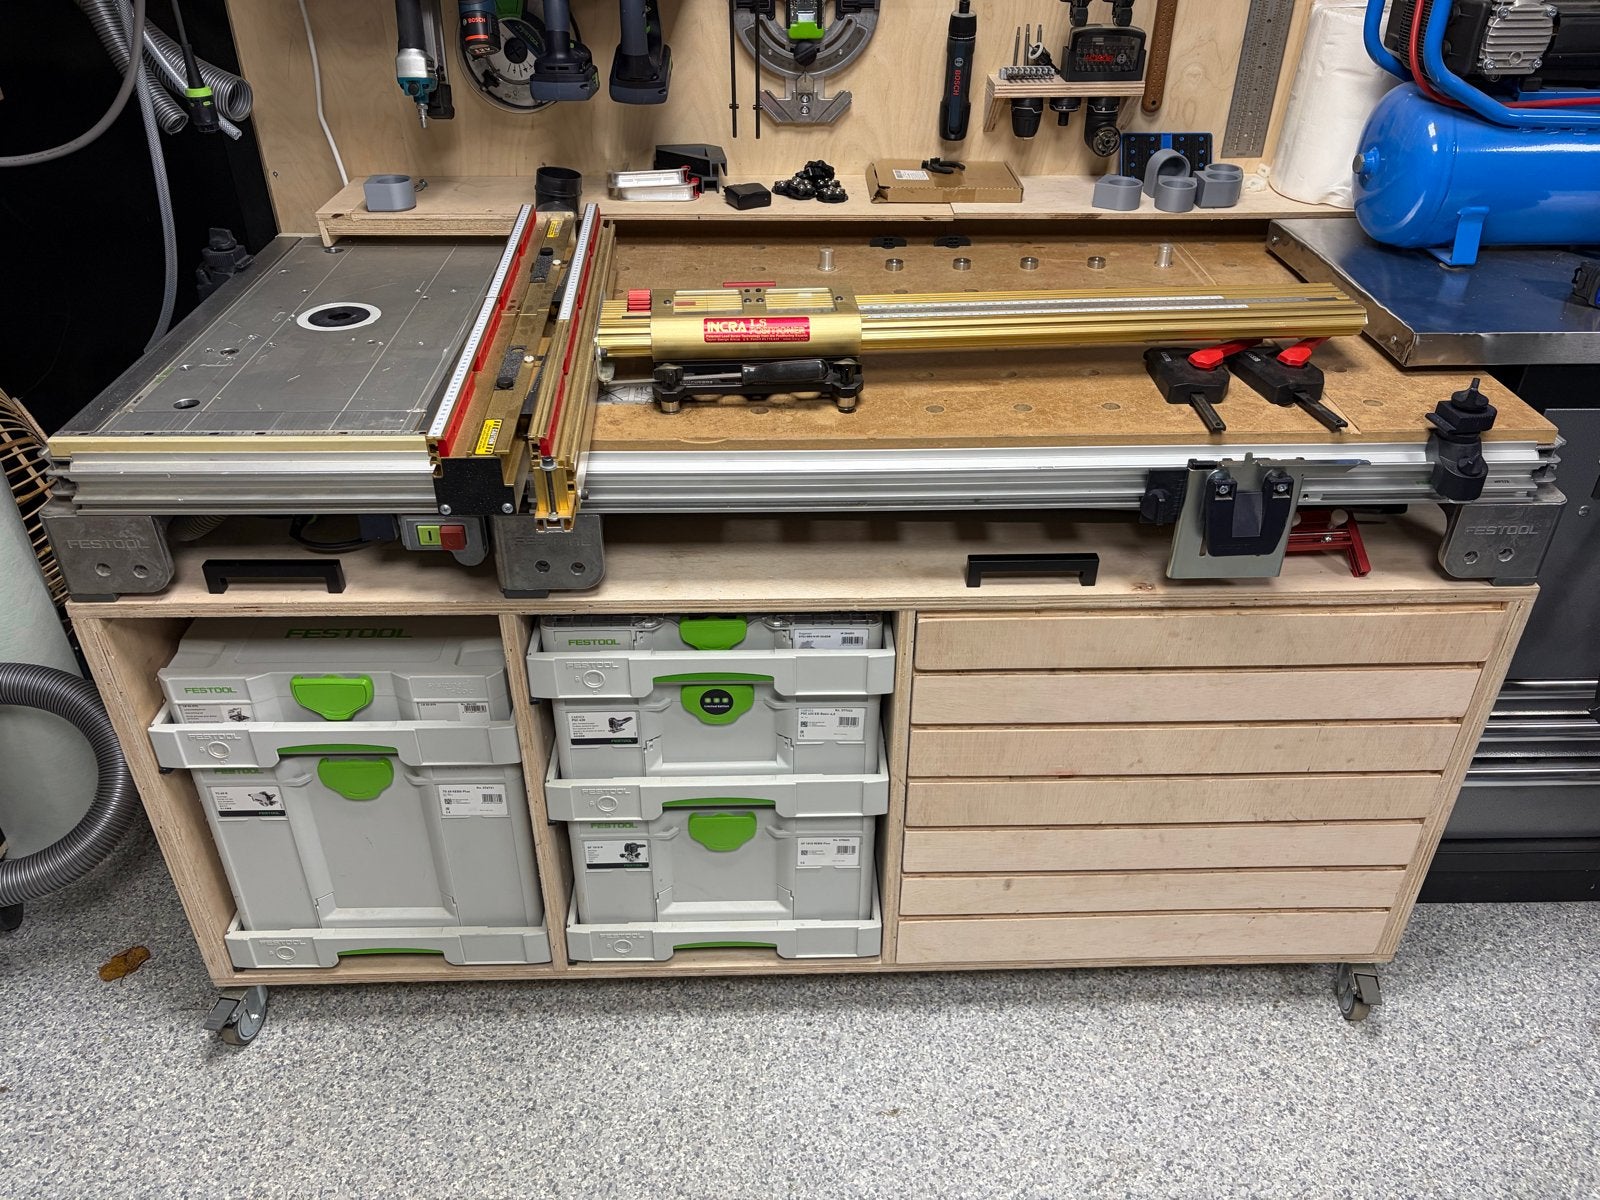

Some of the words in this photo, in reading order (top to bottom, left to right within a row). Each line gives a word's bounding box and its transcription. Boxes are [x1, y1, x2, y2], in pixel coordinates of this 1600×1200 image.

[467, 16, 486, 24] BOSCH
[952, 69, 961, 97] BOSCH
[706, 321, 747, 333] INCRA
[750, 319, 767, 327] LS
[1465, 525, 1539, 535] FESTOOL
[68, 539, 150, 549] FESTOOL
[285, 628, 413, 639] FESTOOL
[566, 661, 619, 669] FESTOOL
